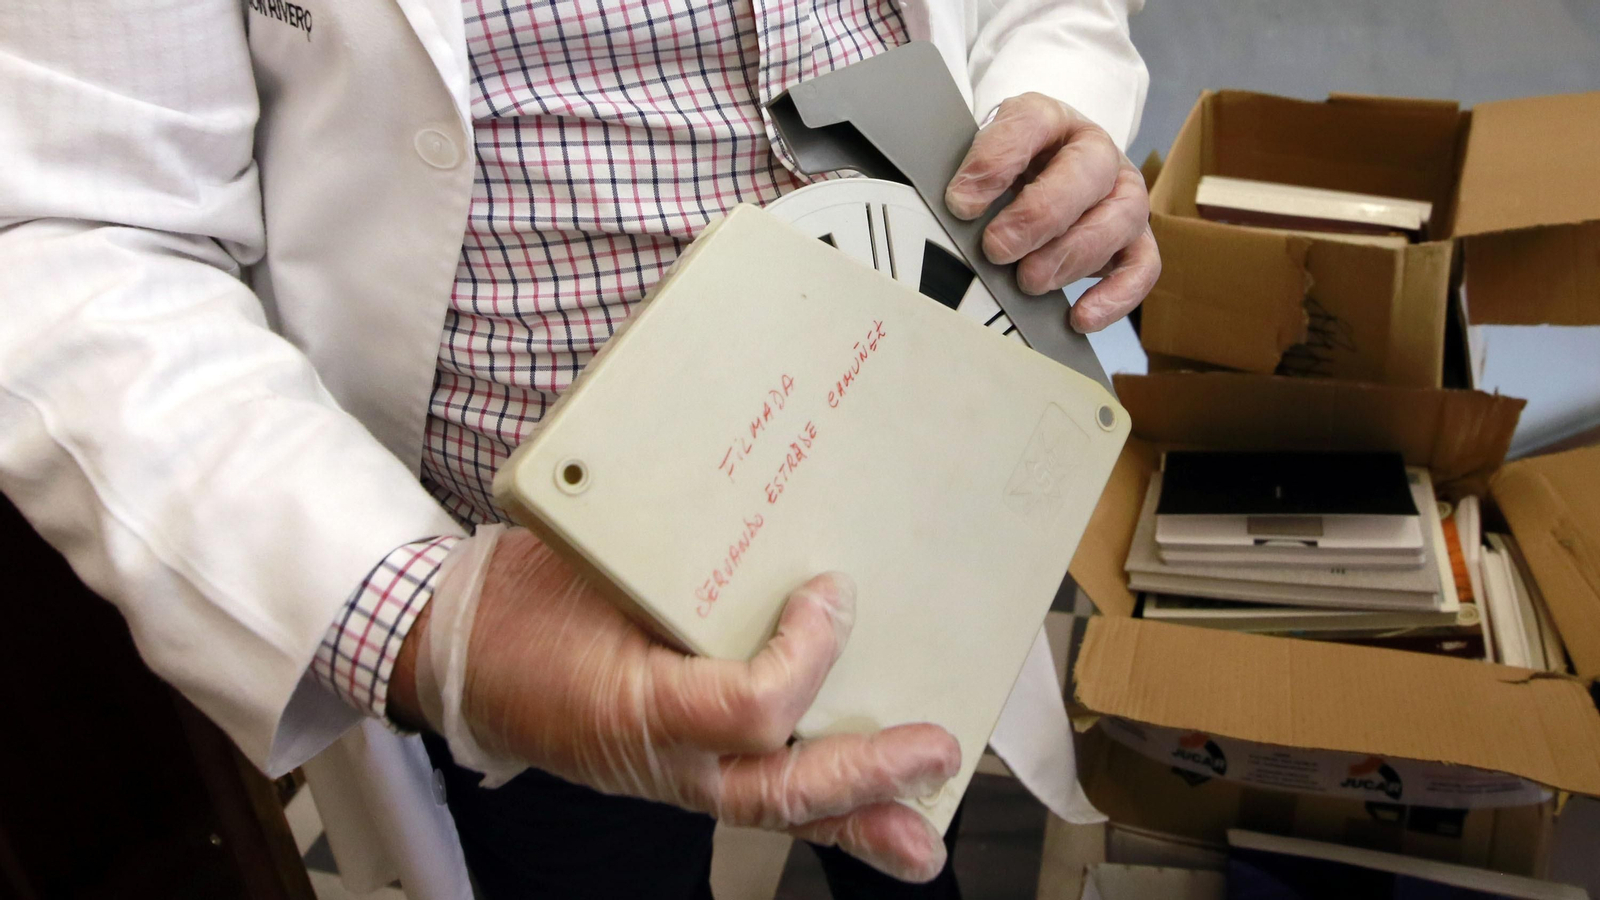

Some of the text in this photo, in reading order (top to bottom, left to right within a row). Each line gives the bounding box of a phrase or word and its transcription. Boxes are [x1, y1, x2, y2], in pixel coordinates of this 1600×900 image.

[268, 0, 312, 33] RIVERO
[696, 513, 763, 618] SERVANDO
[1340, 777, 1401, 794] JUCAR
